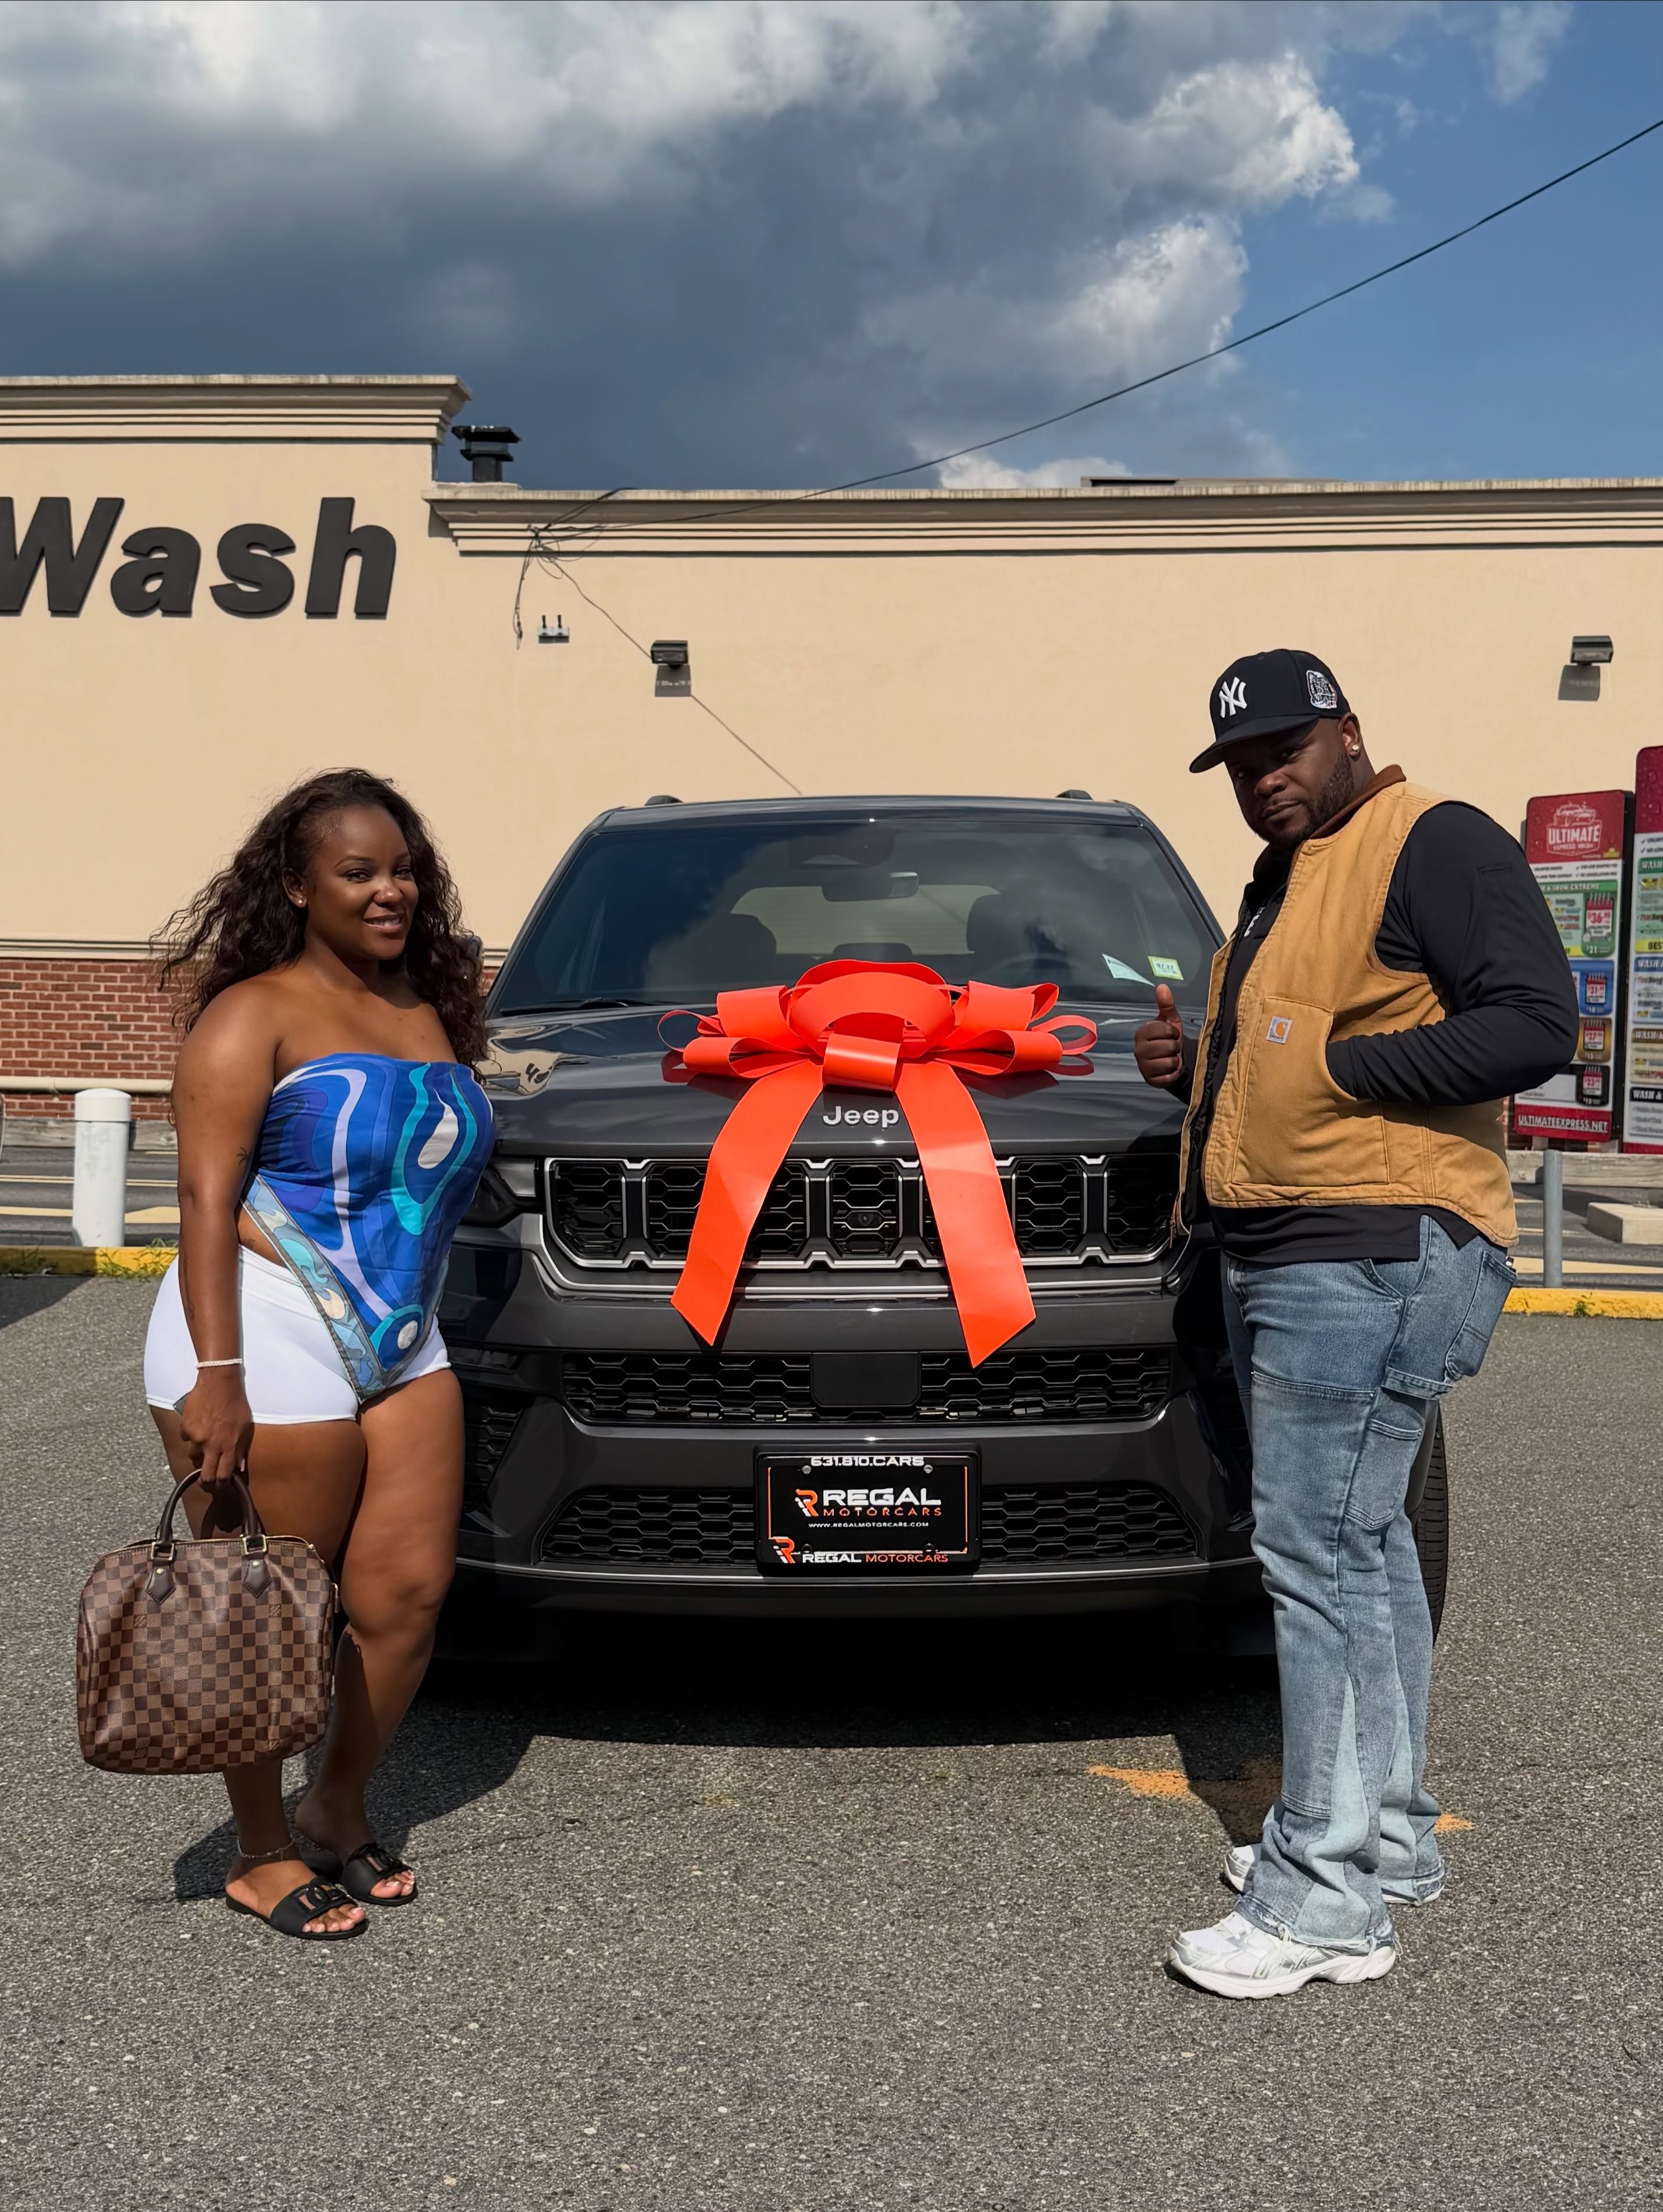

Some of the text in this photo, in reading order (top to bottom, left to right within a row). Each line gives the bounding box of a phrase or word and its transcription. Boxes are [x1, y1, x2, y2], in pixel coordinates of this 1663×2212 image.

[0, 496, 396, 616] Wash
[1219, 677, 1248, 718] NY
[1548, 825, 1600, 844] ULTIMATE
[1641, 860, 1662, 869] WASH
[1636, 1030, 1657, 1040] WASH
[1633, 1090, 1662, 1100] WASH &
[823, 1105, 899, 1128] Jeep
[1518, 1114, 1608, 1133] ULTIMATEEXPRESS.NET
[811, 1456, 924, 1466] 631.810.CARS
[823, 1487, 942, 1506] REGAL
[823, 1507, 942, 1517] MOTORCARS
[802, 1552, 862, 1563] REGAL
[865, 1553, 949, 1563] MOTORCARS
